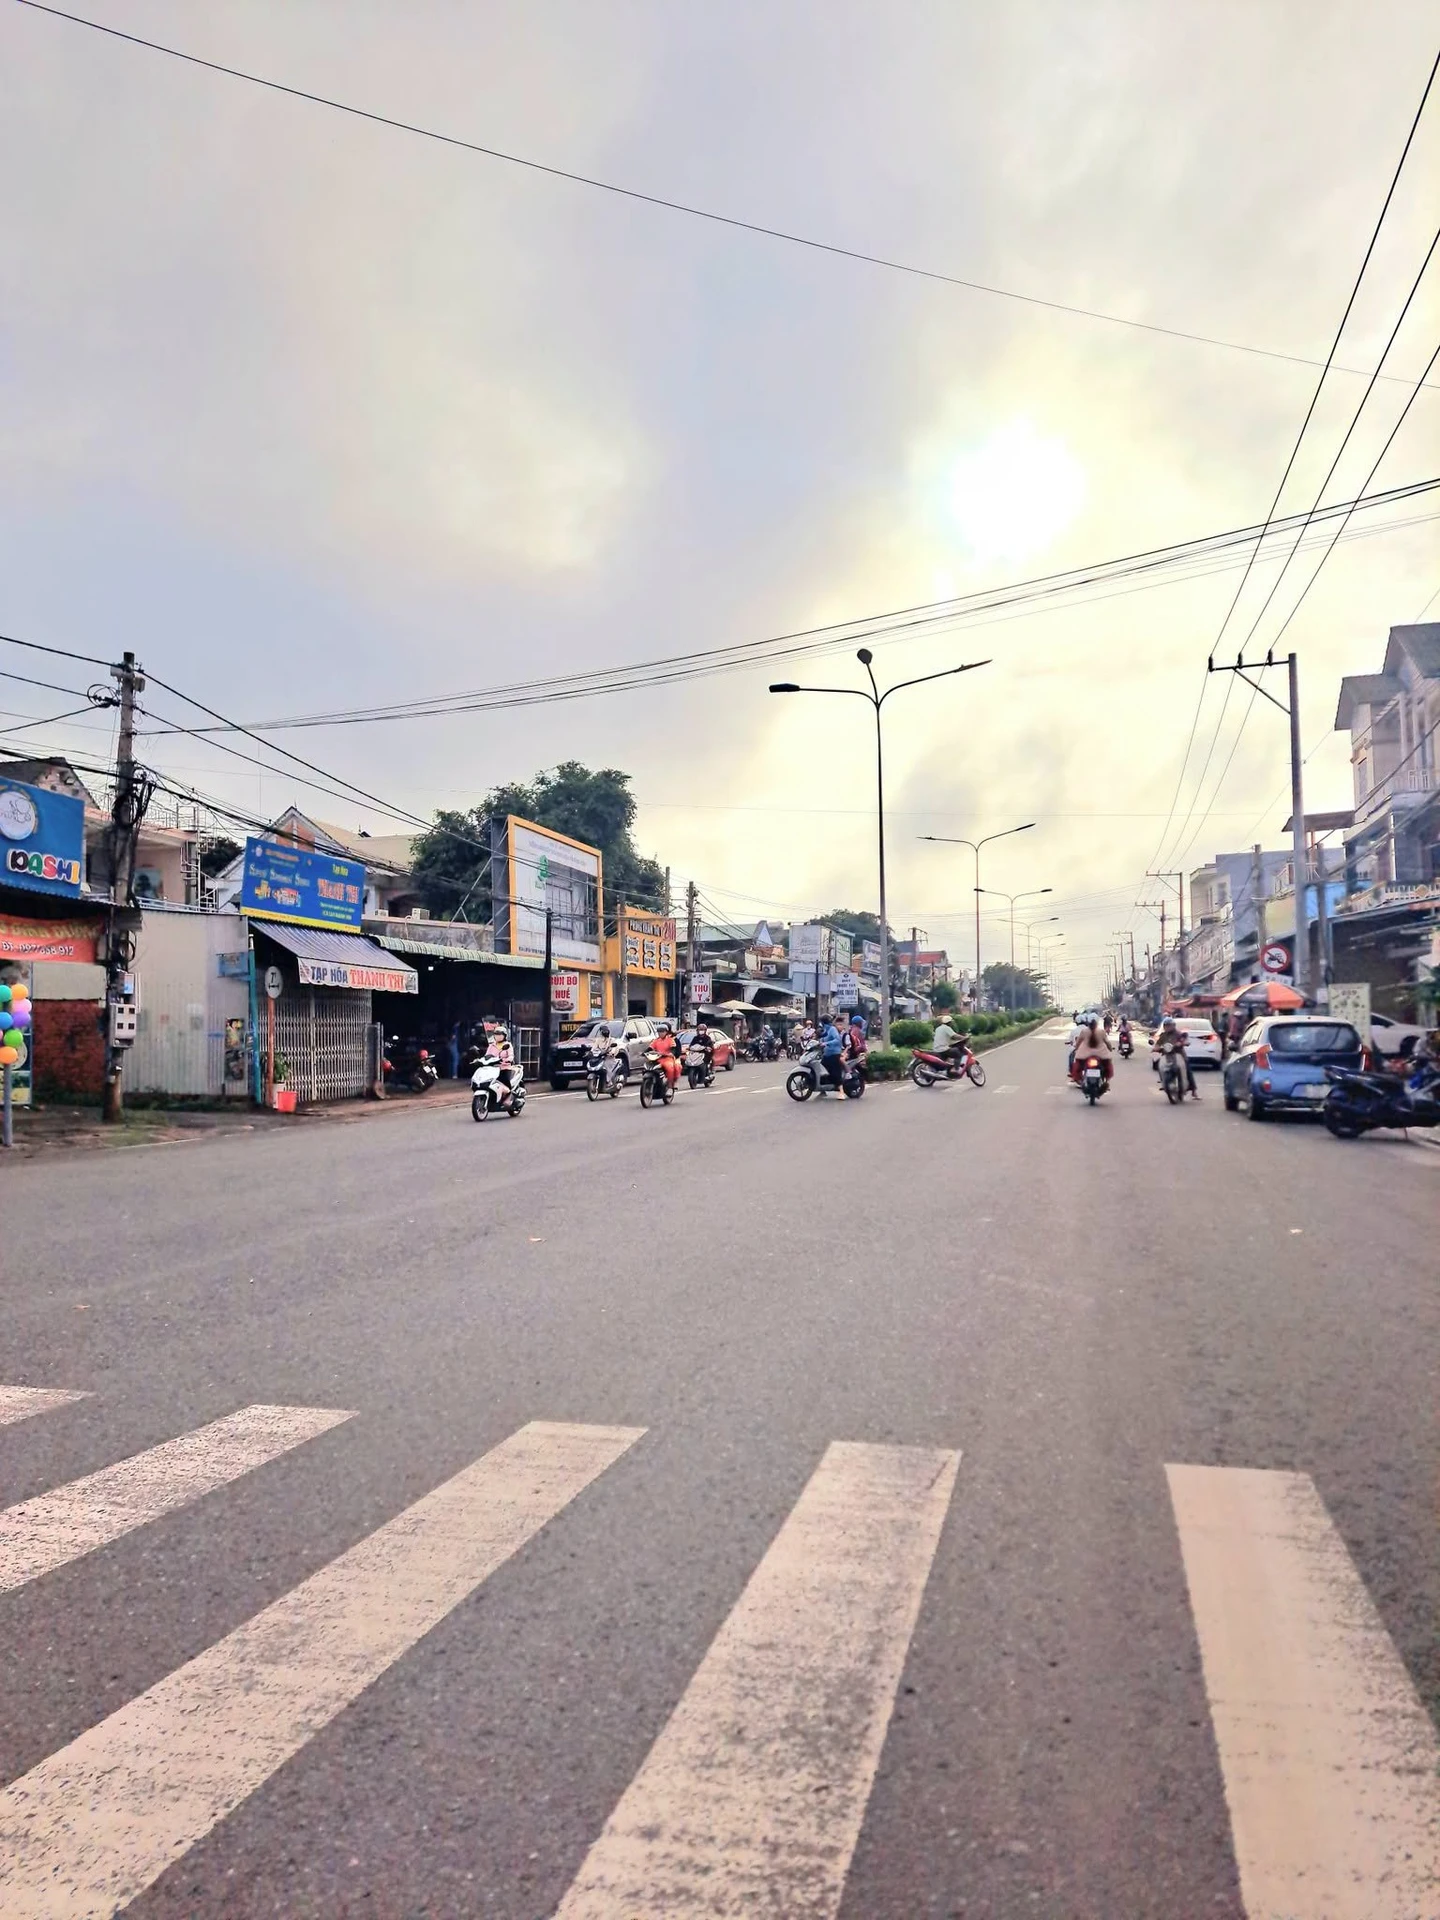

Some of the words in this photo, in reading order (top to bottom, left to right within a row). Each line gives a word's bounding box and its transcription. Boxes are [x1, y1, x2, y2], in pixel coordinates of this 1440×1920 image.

[310, 966, 328, 983] TẠP
[330, 966, 349, 984] HÓA
[349, 969, 386, 988] THANH
